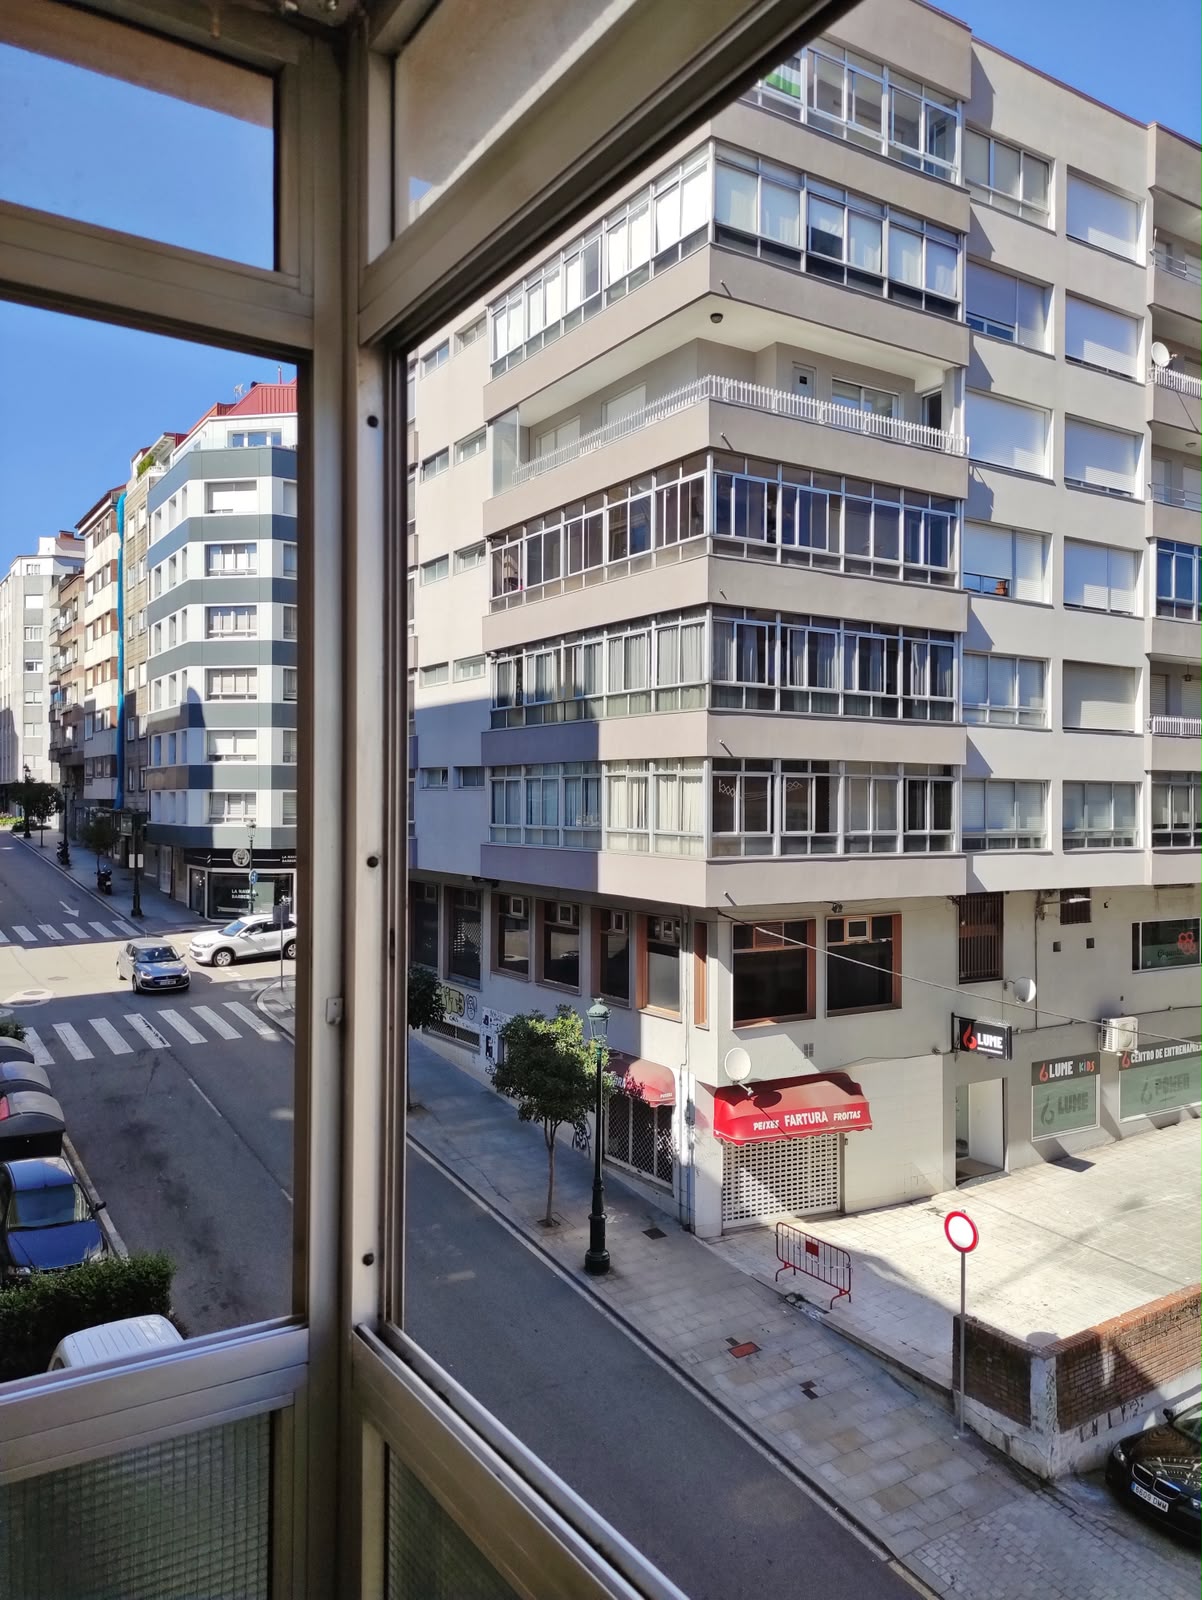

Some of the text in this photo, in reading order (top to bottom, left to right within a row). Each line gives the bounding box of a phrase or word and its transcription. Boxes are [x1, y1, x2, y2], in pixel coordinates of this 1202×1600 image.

[977, 1032, 1003, 1049] LUME
[1130, 1050, 1155, 1064] CENTRO
[1155, 1047, 1164, 1060] DE
[1048, 1060, 1074, 1078] LUME
[1057, 1091, 1089, 1115] LUME
[753, 1110, 861, 1131] PEIXES FARTURA FROITAS
